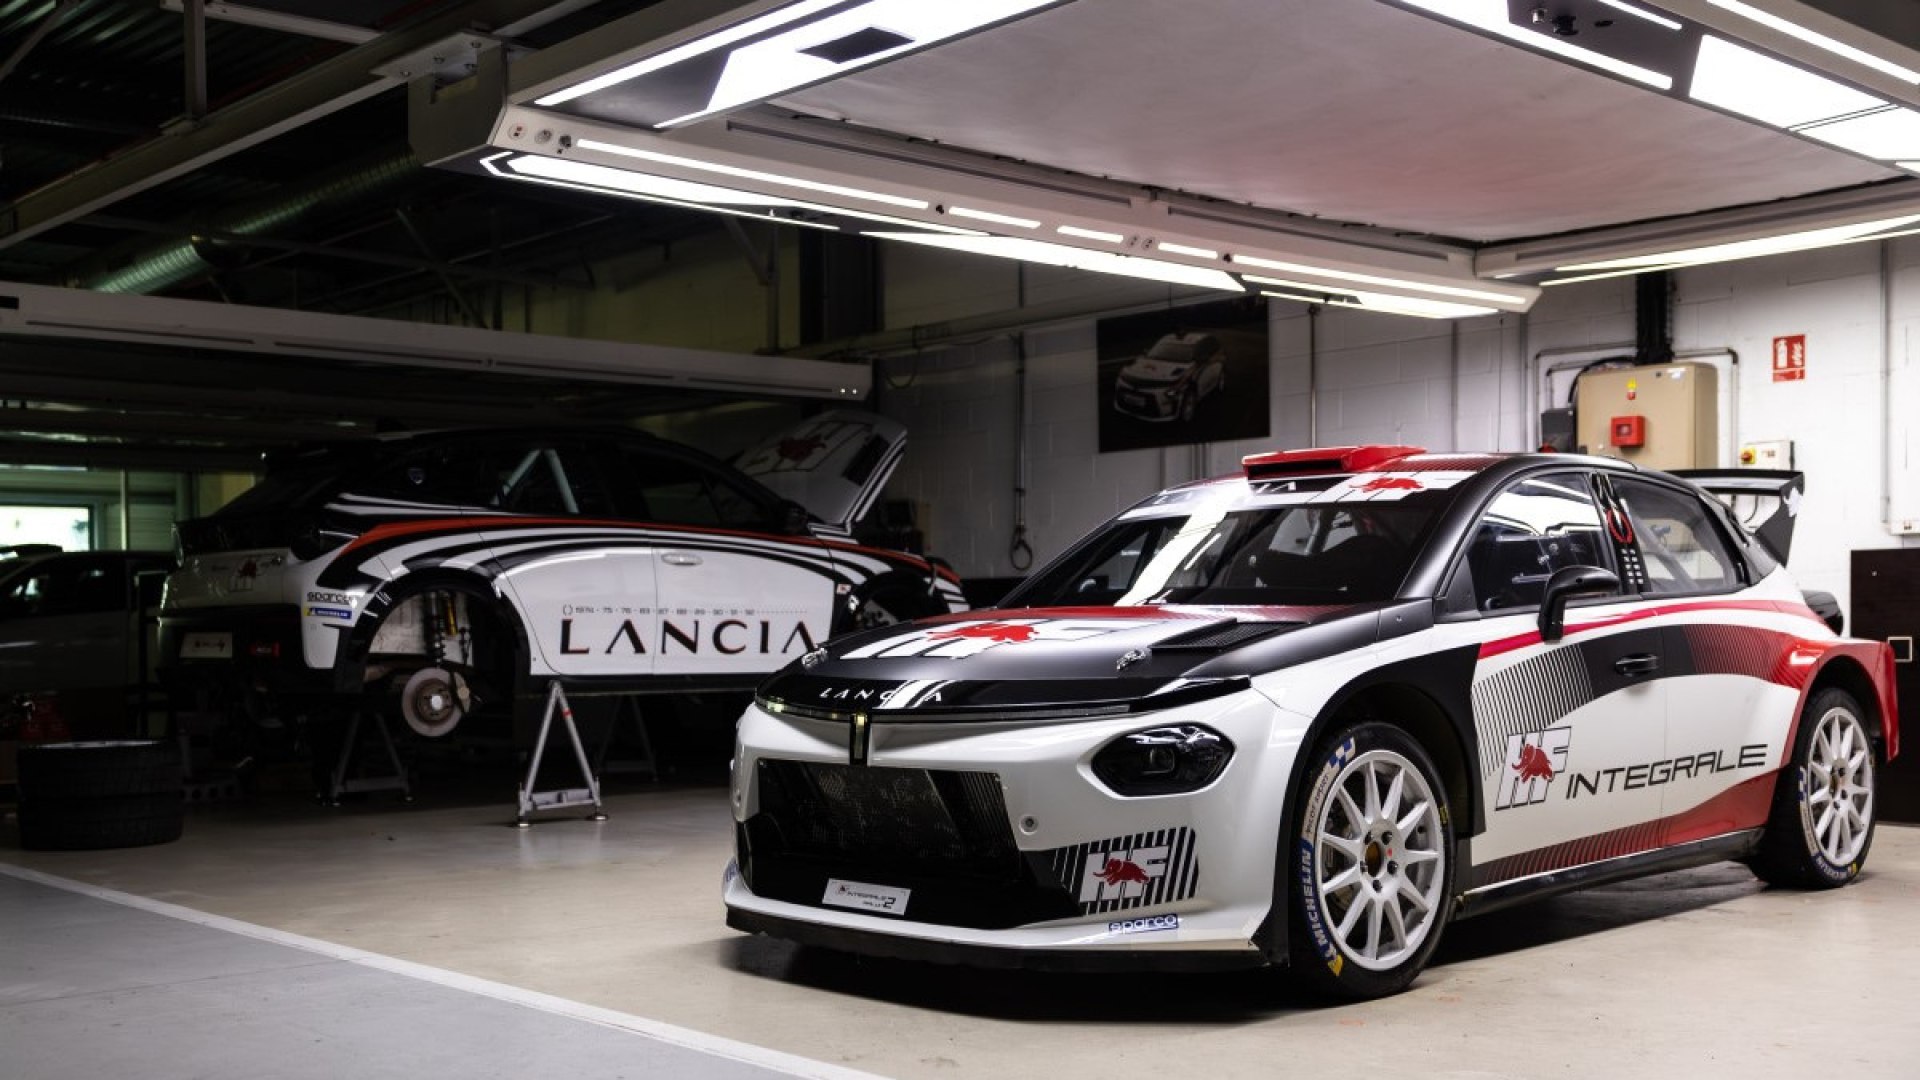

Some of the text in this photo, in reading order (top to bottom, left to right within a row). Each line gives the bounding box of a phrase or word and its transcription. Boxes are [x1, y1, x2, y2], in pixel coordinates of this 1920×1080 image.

[307, 591, 356, 605] sparc
[560, 618, 816, 655] LANCIA
[1566, 743, 1769, 800] INTEGRALE
[1302, 848, 1329, 946] MICHELIN
[1109, 914, 1177, 934] sparco
